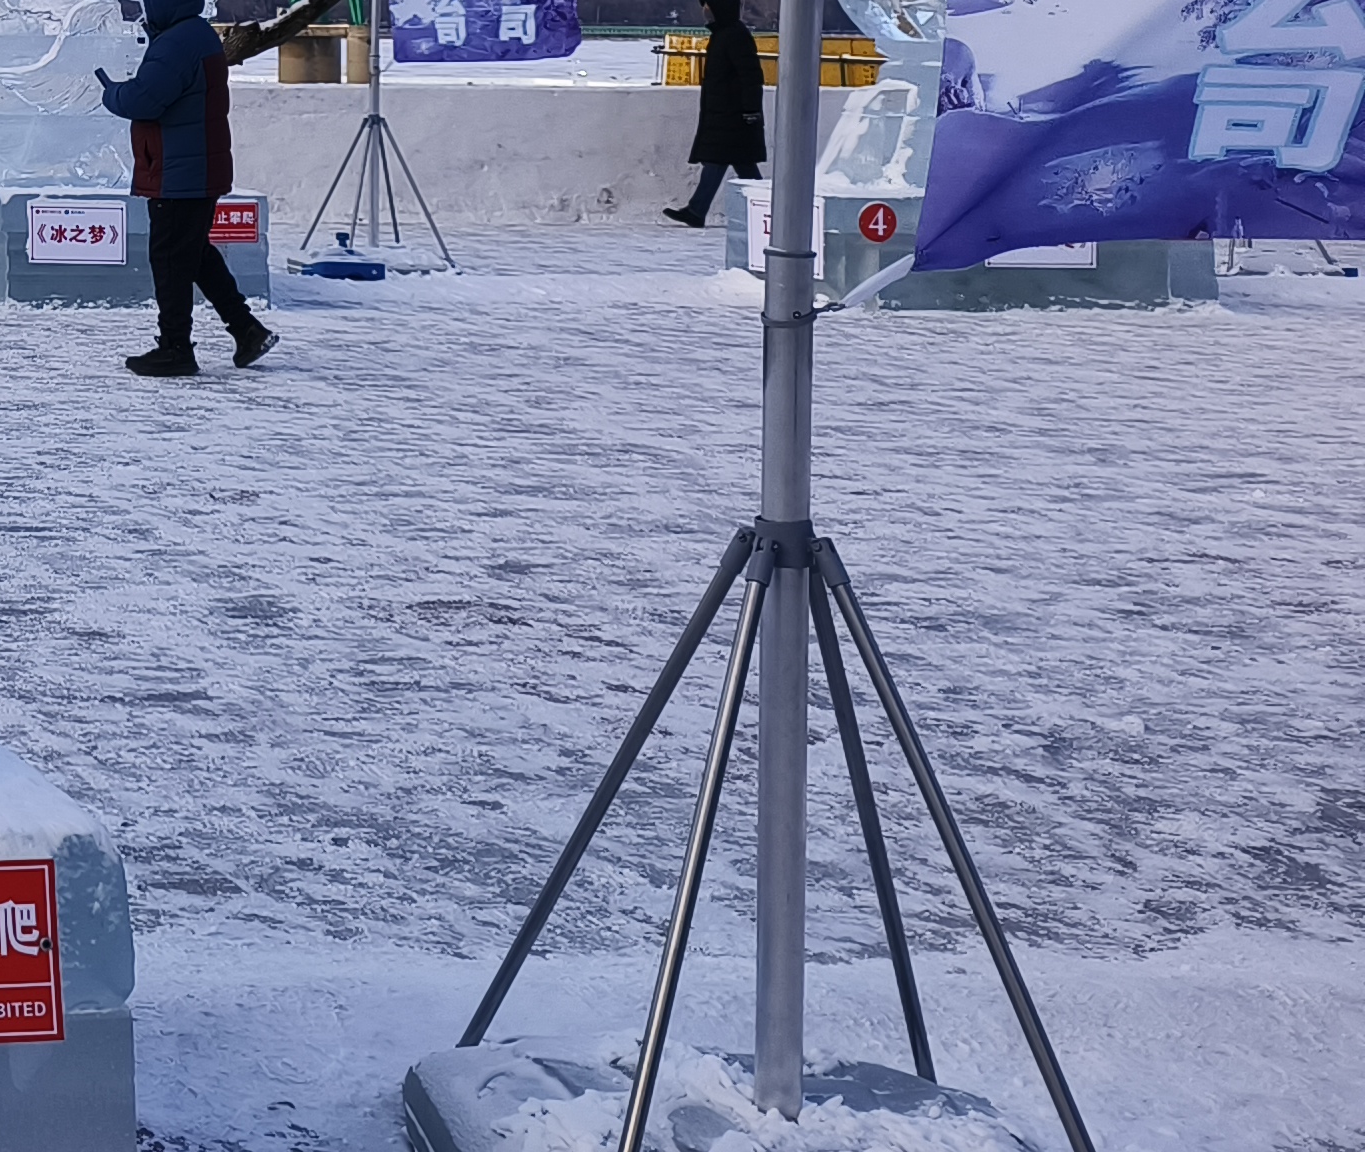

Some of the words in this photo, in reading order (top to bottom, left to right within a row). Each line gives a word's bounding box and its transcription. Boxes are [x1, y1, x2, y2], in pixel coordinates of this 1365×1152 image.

[213, 211, 255, 224] 止攀爬
[868, 207, 887, 236] 4
